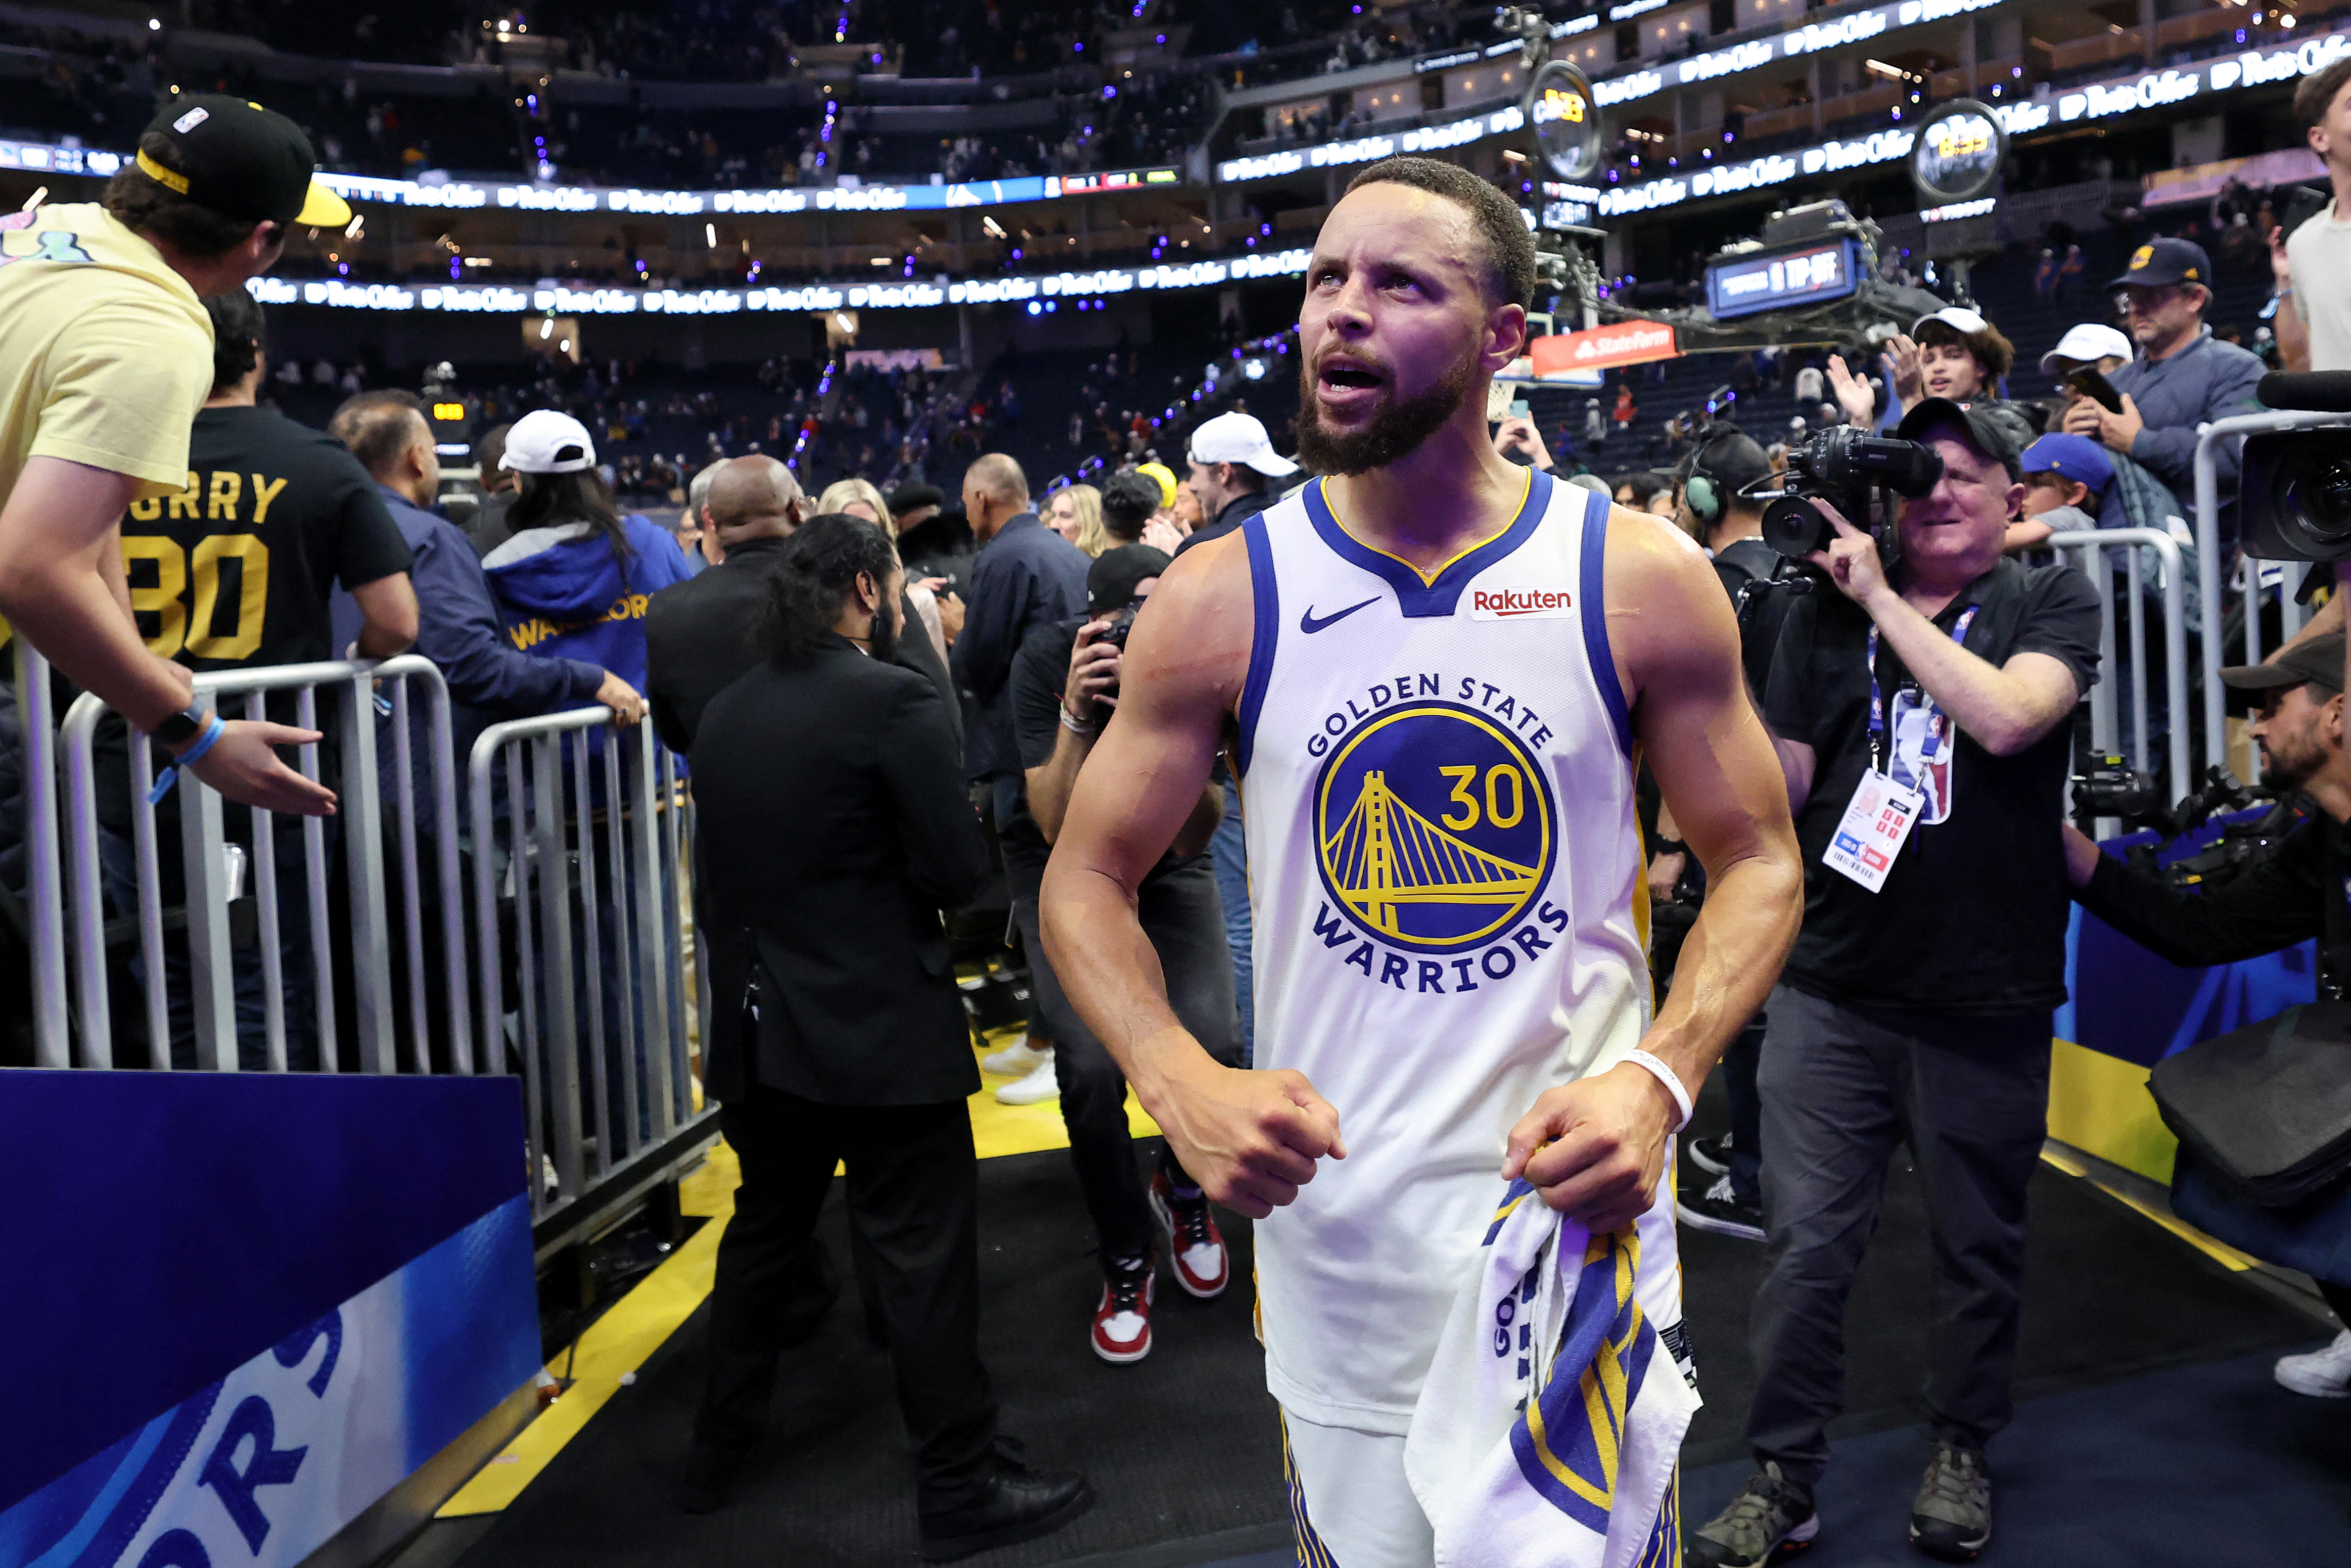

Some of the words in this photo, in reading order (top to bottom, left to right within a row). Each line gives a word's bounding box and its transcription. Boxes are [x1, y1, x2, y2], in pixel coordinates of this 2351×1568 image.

[129, 471, 289, 524] RRY
[1474, 589, 1571, 611] Rakuten
[1308, 674, 1440, 757] GOLDEN
[1459, 677, 1554, 750] STATE
[1439, 764, 1524, 831] 30
[1313, 901, 1569, 994] WARRIORS
